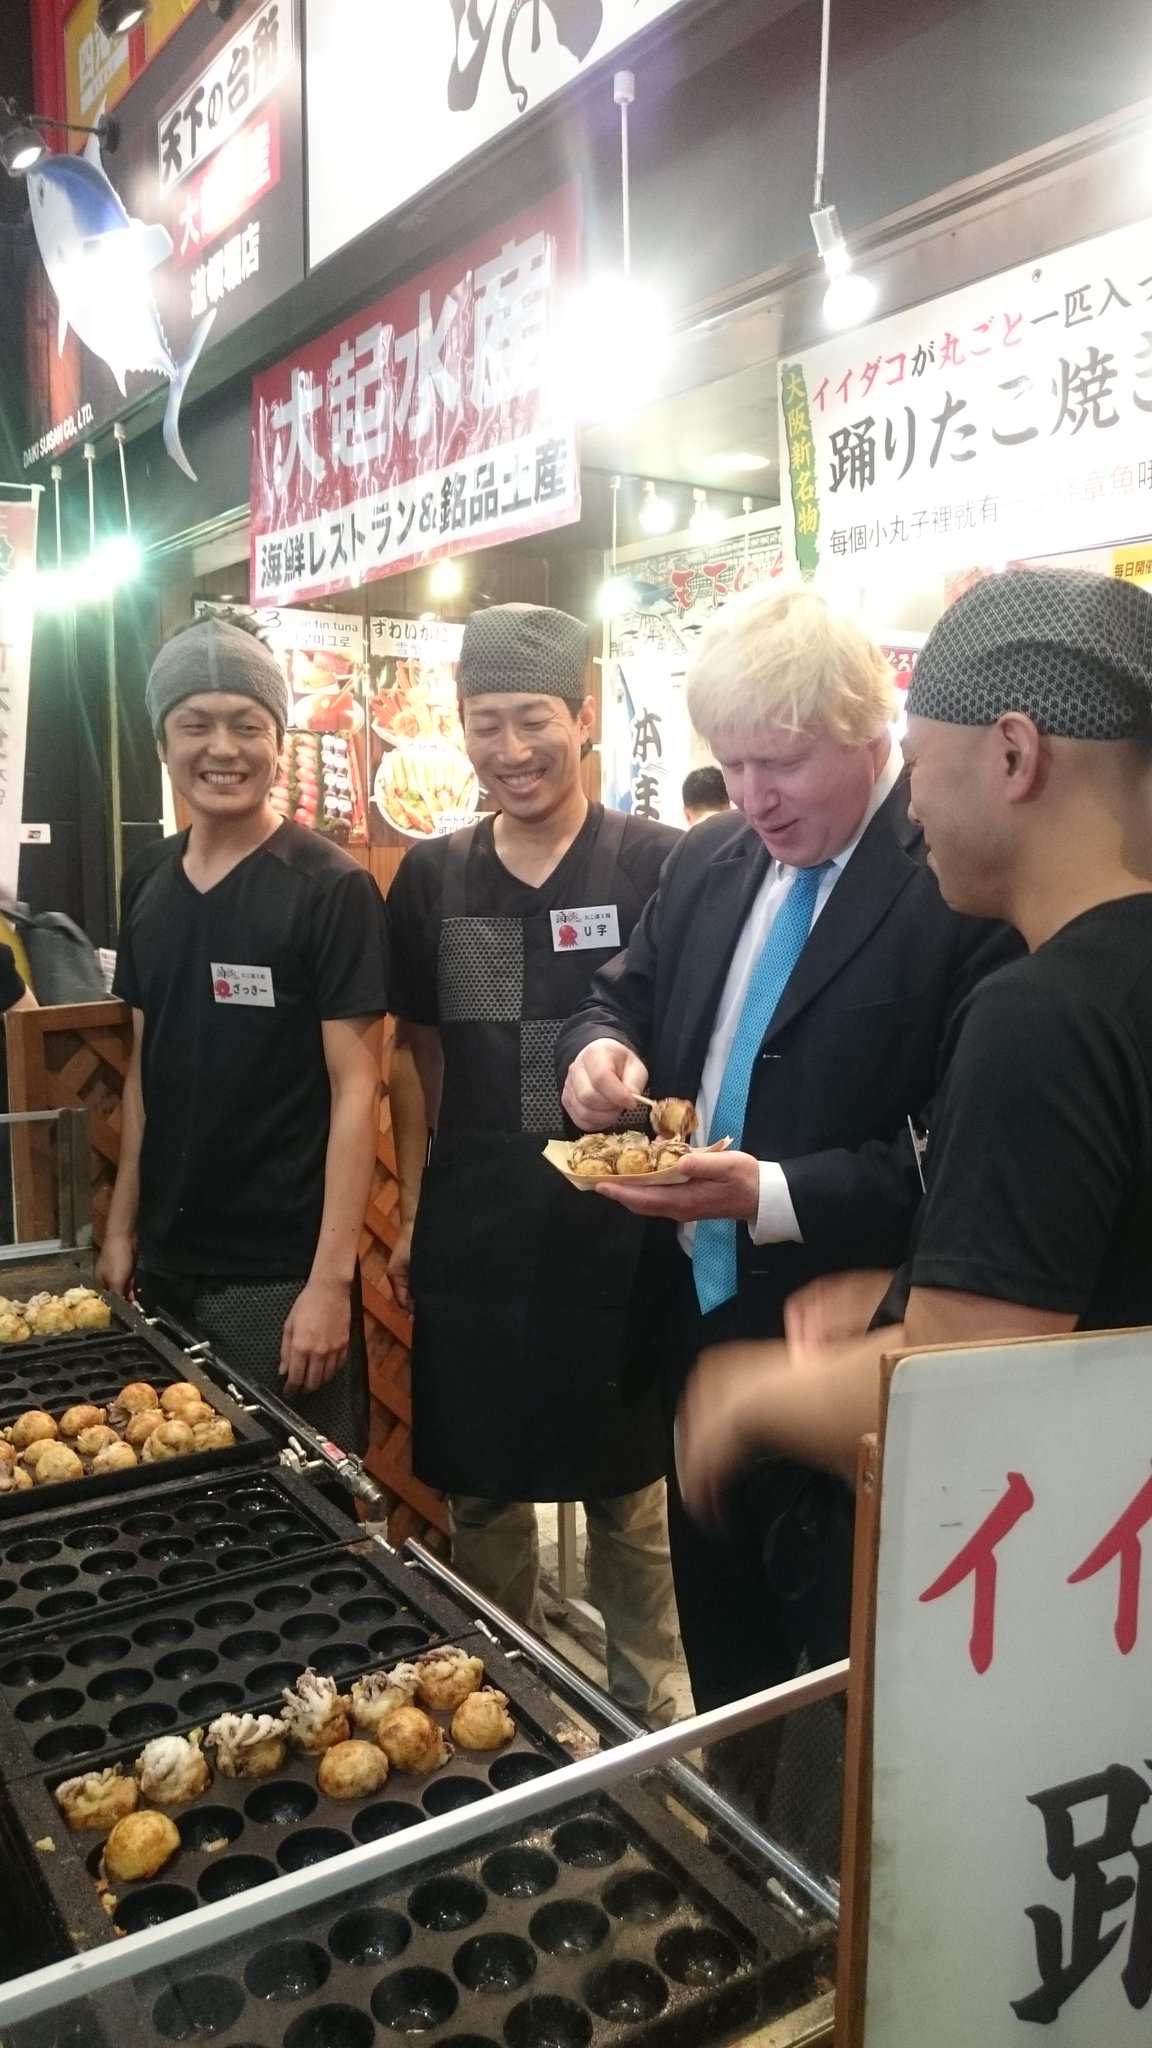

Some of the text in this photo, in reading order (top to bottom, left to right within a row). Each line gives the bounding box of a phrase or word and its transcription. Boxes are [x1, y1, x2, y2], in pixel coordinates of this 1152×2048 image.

[161, 4, 279, 185] 天下の台所
[271, 230, 549, 497] 大起水産
[23, 441, 40, 469] DAIKI
[785, 372, 819, 535] 大阪新名物
[333, 621, 358, 633] tuna
[233, 983, 268, 996] ざっきー
